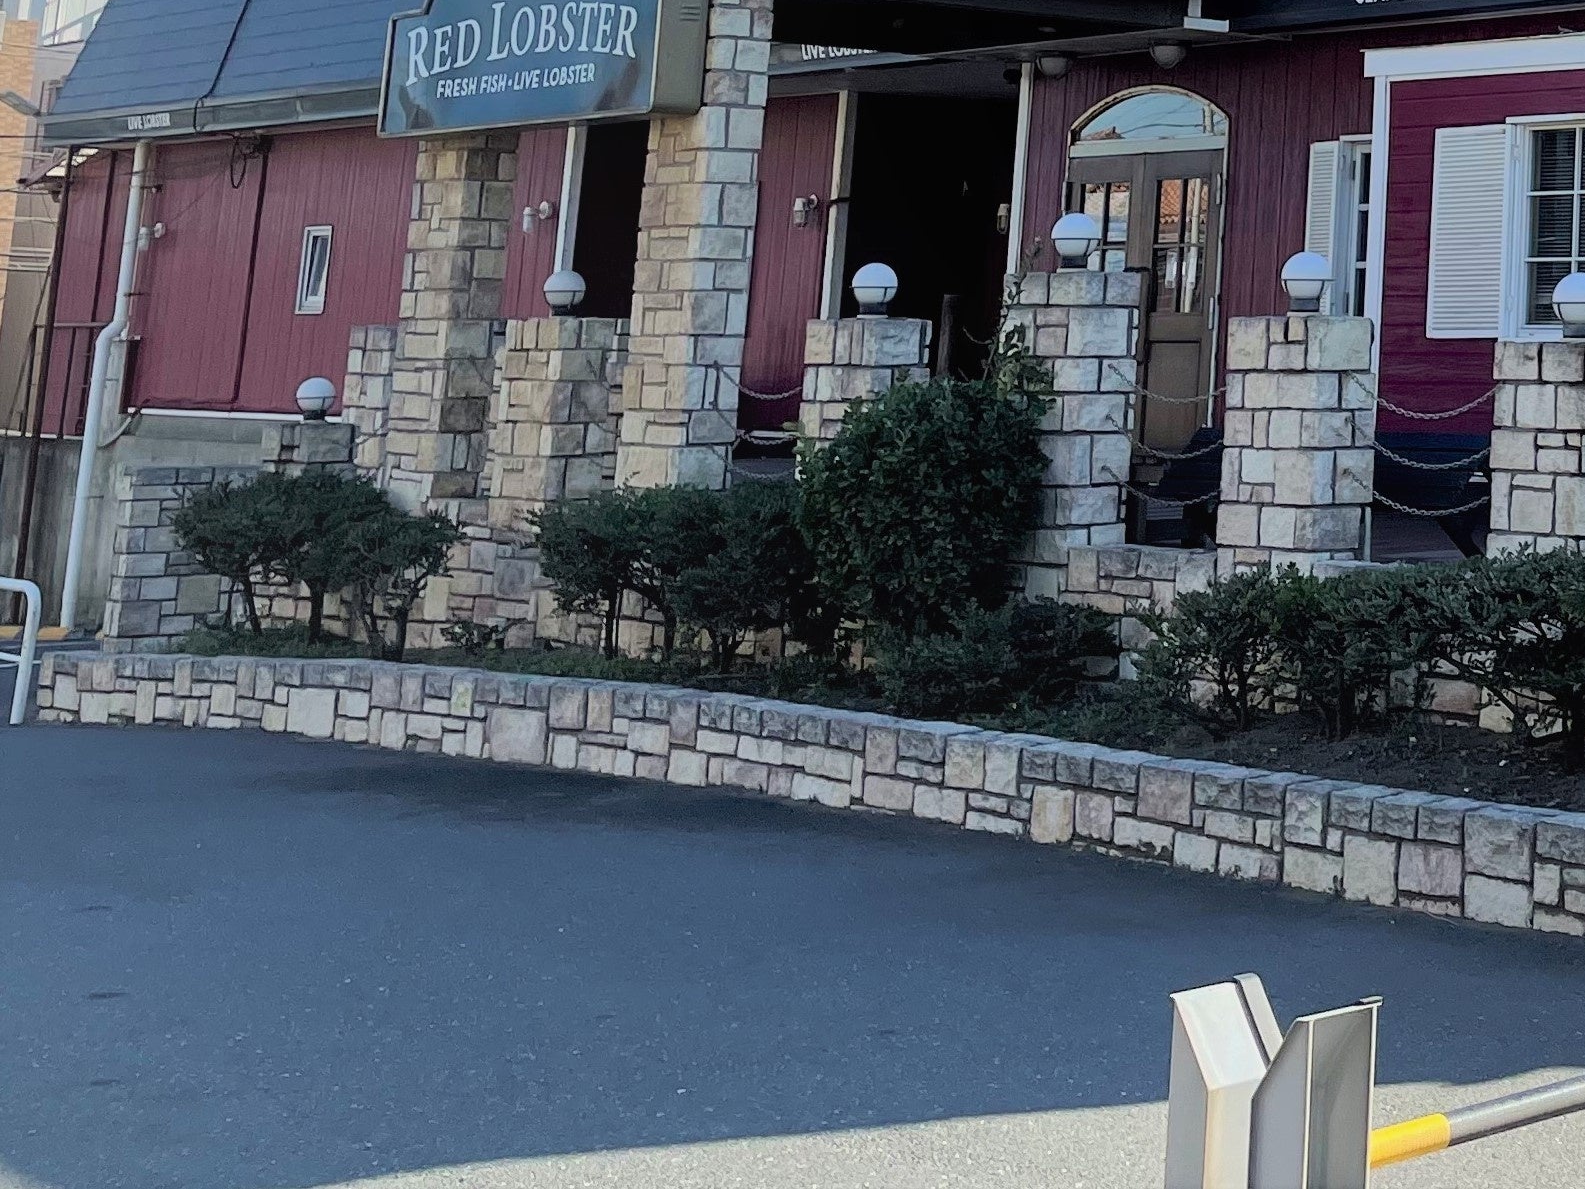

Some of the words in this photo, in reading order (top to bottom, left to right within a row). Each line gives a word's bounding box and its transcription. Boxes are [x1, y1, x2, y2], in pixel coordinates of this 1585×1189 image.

[405, 19, 482, 87] RED
[486, 2, 638, 60] LOBSTER
[801, 44, 826, 61] LIVE
[436, 76, 478, 99] FRESH
[479, 74, 508, 94] FISH
[513, 69, 541, 91] LIVE
[543, 62, 595, 87] LOBSTER
